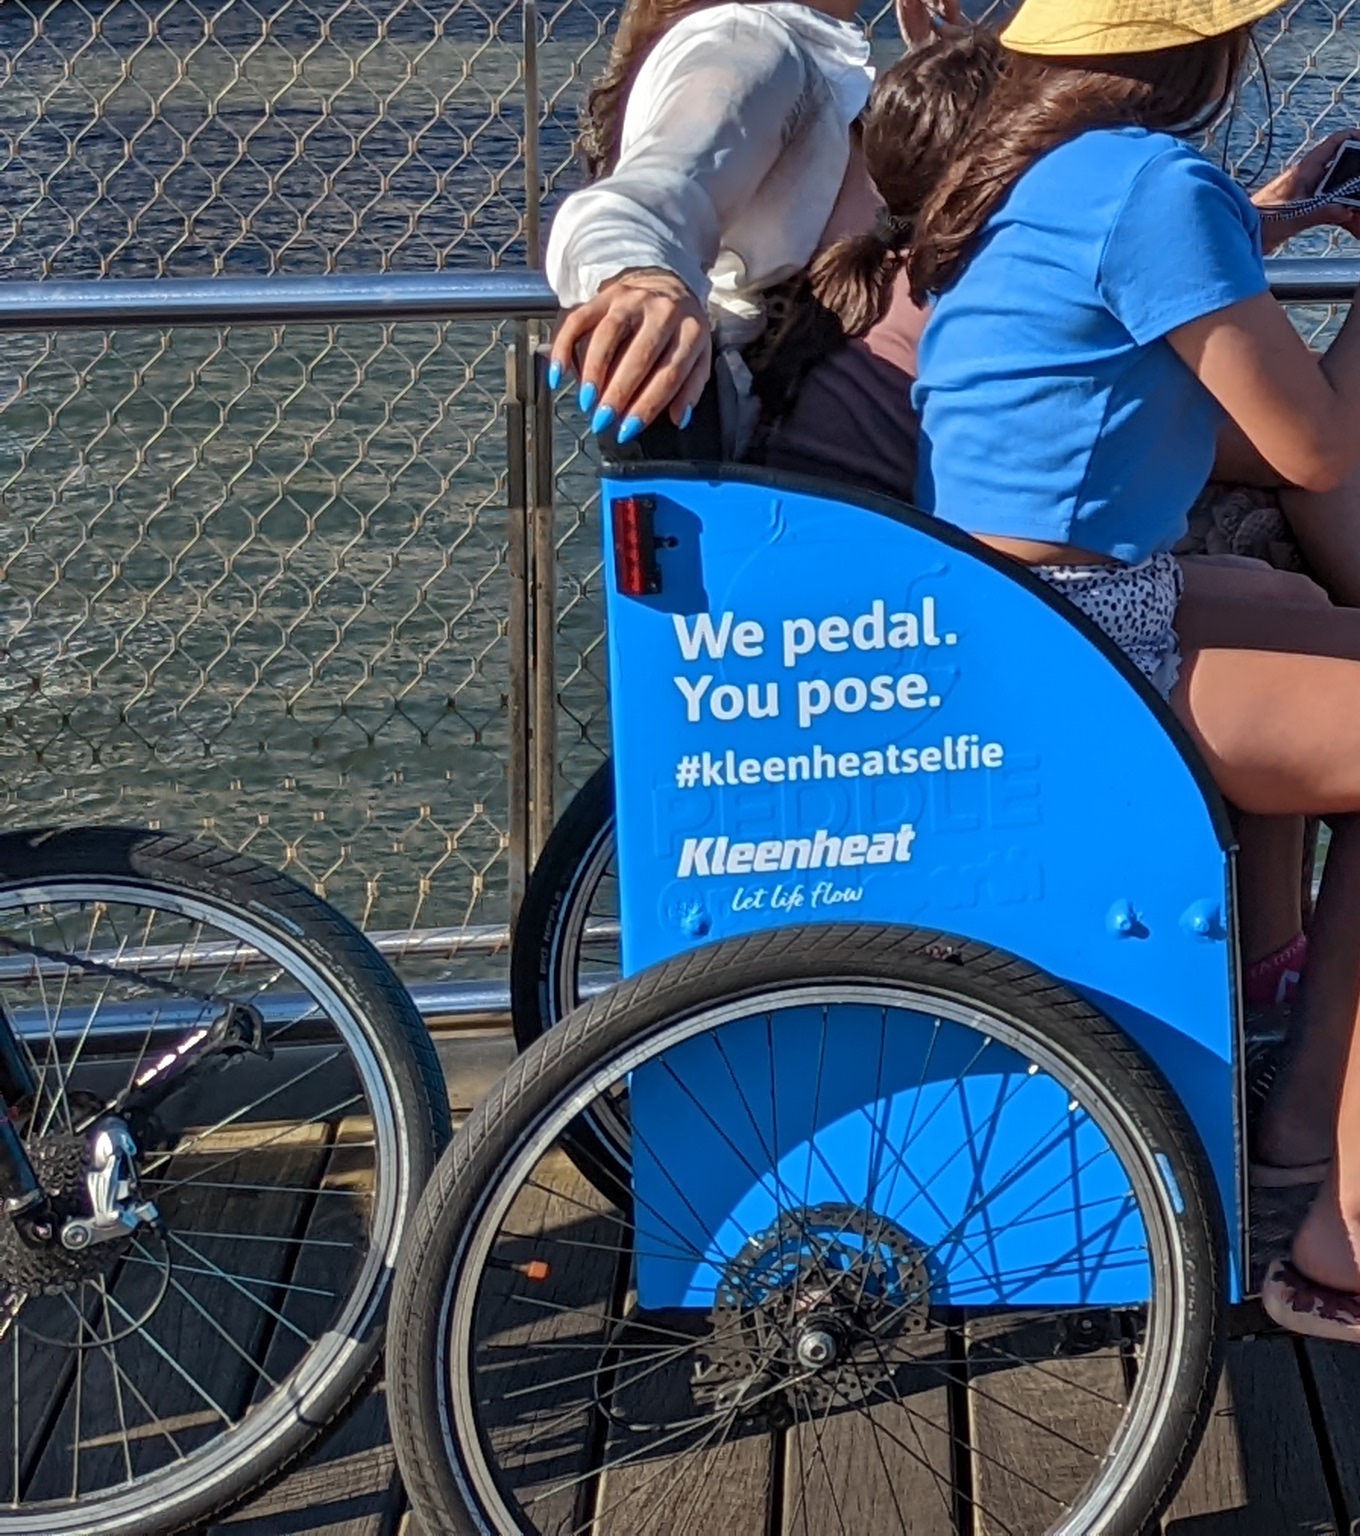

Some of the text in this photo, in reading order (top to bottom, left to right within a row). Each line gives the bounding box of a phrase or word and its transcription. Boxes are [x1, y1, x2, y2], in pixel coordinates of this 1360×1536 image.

[672, 596, 957, 667] We pedal.
[673, 673, 941, 728] You pose.
[675, 735, 1004, 788] #kleenheatselfie
[677, 823, 916, 878] Kleenheat
